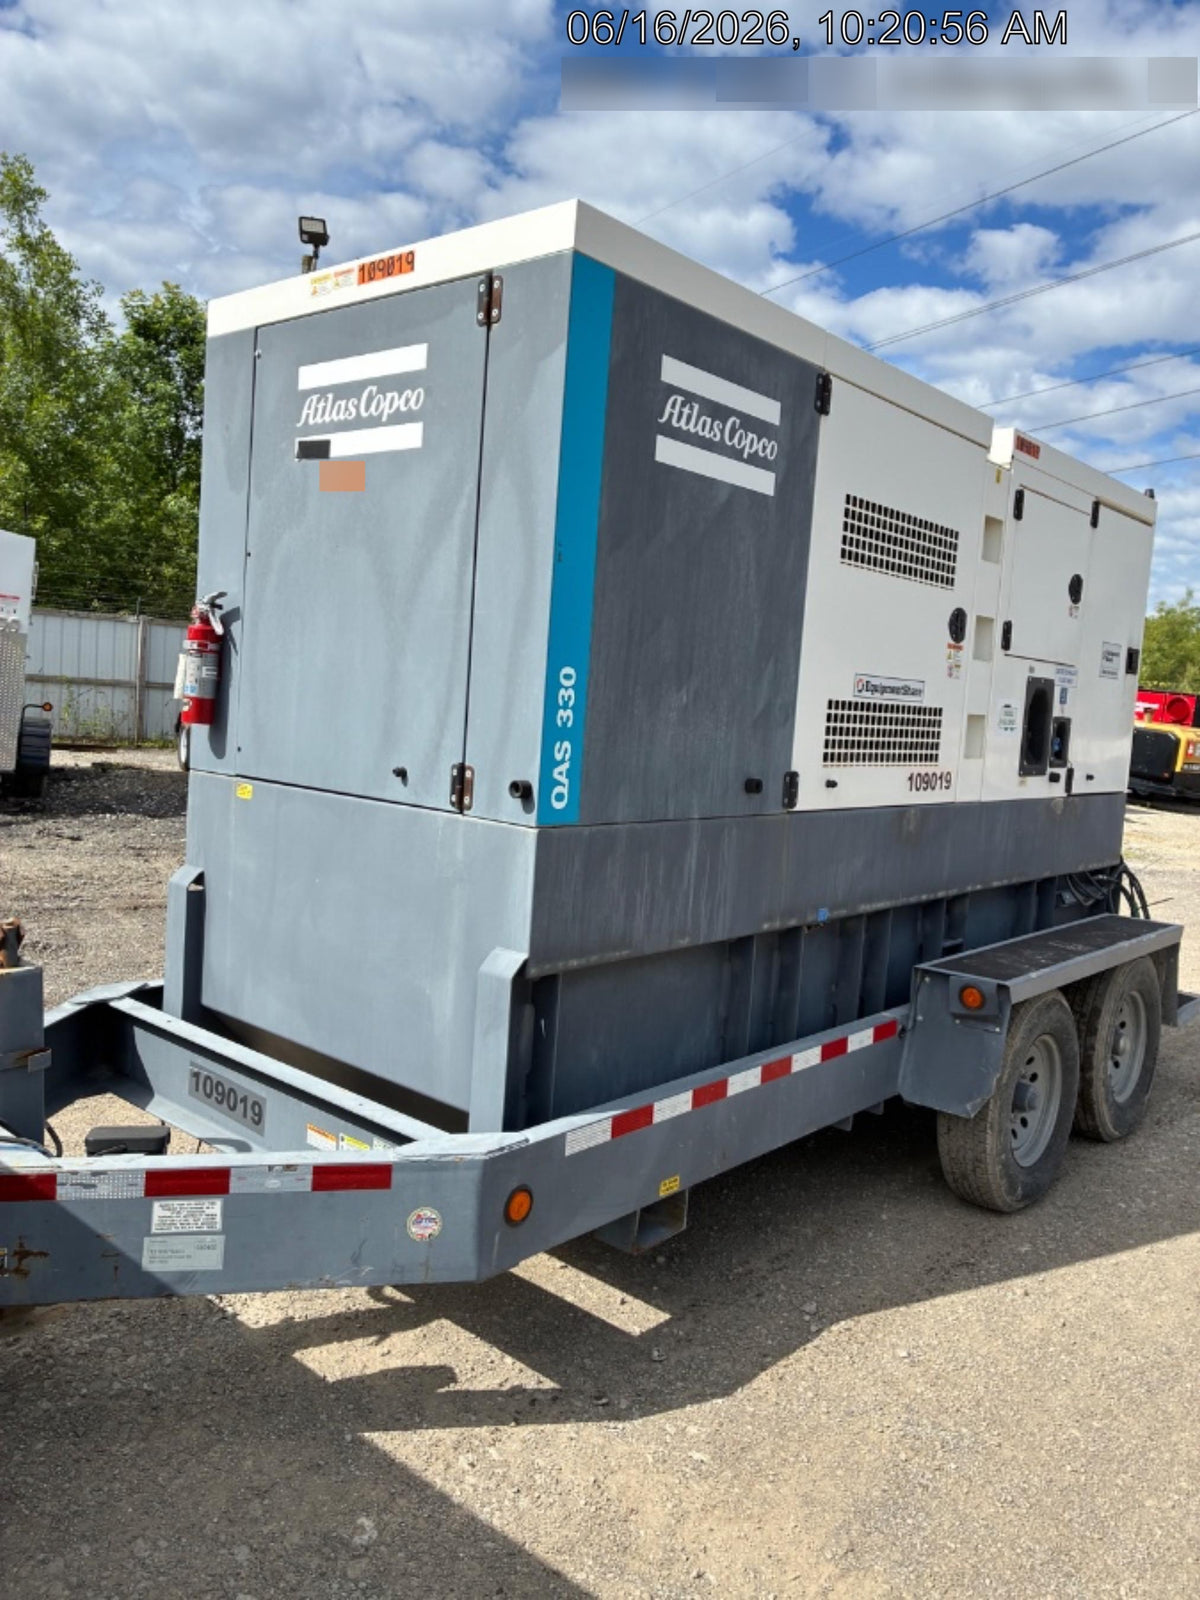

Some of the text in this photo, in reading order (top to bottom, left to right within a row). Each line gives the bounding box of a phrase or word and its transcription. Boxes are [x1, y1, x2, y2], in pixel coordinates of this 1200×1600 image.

[358, 250, 415, 284] 109019
[551, 666, 576, 810] QAS 330
[908, 772, 952, 792] 109019
[190, 1070, 263, 1127] 109019
